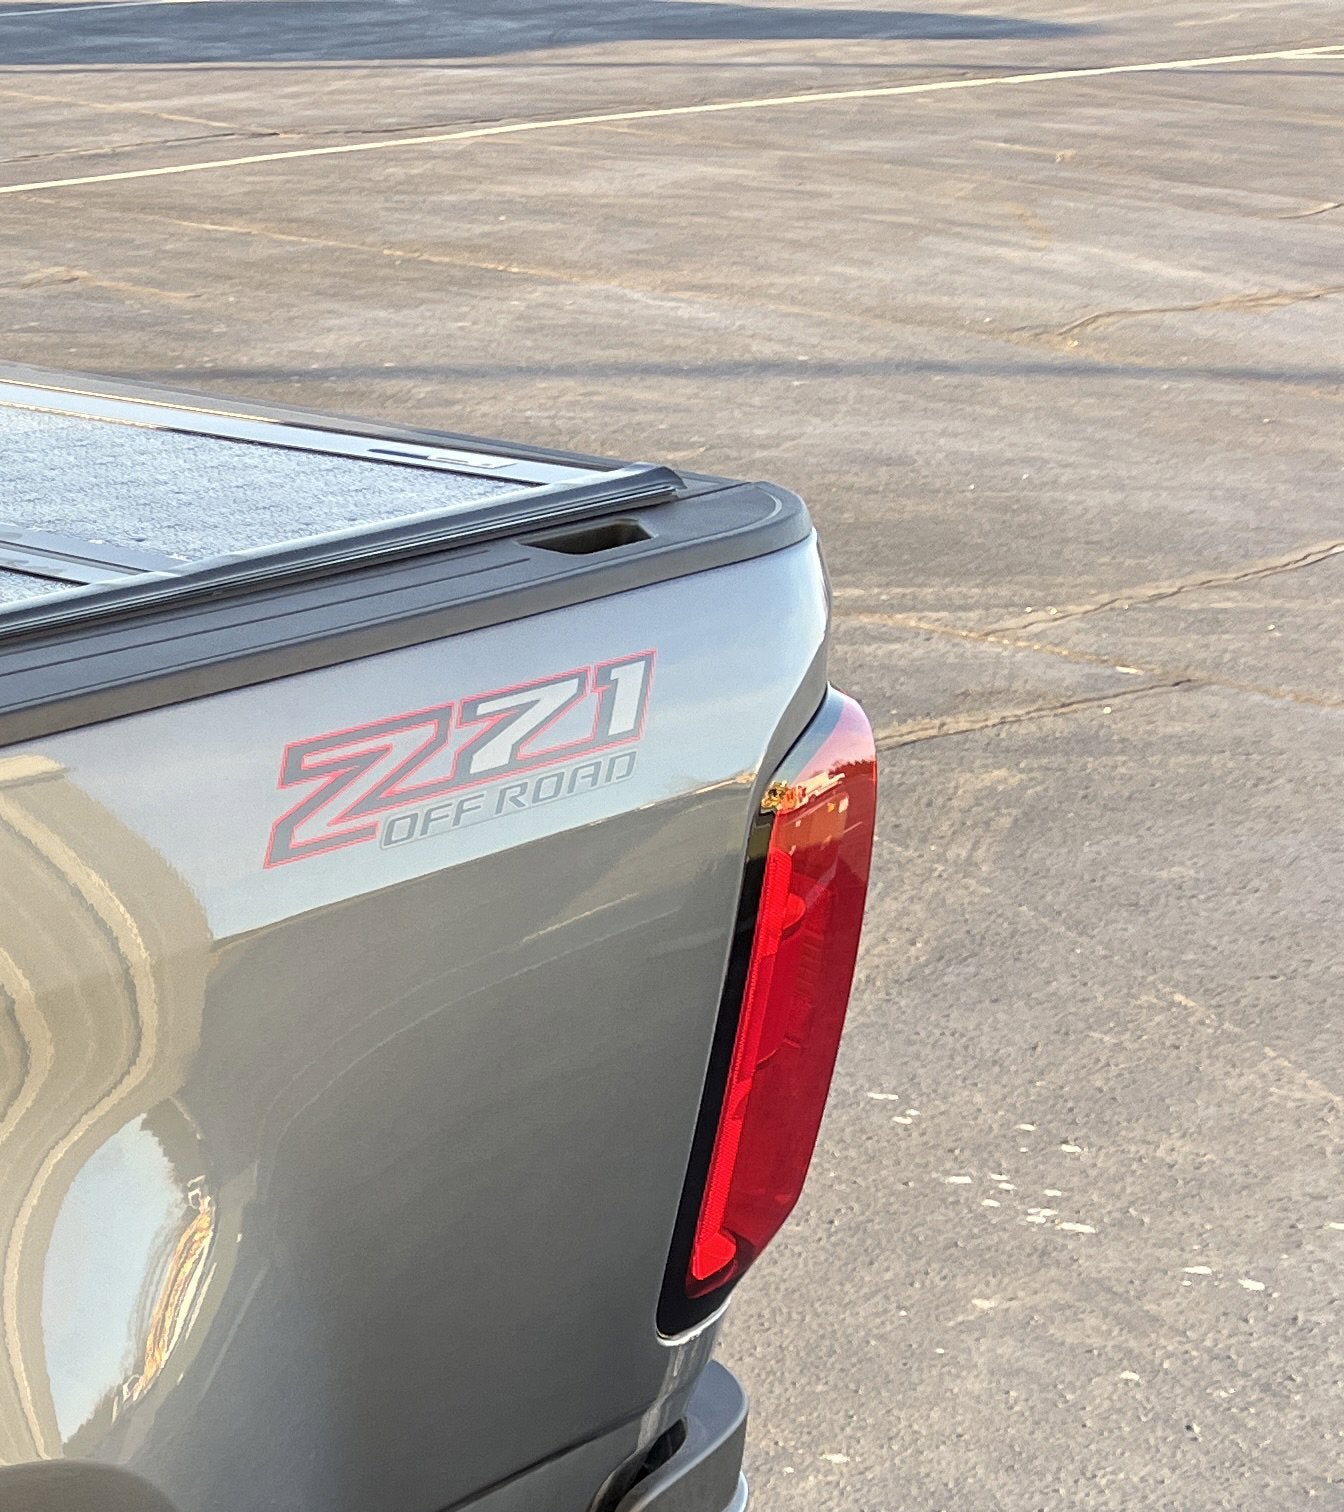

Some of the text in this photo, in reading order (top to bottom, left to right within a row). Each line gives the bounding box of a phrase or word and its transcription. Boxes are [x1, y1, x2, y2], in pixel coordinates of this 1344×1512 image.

[263, 648, 658, 870] Z71
[382, 749, 638, 848] OFF ROAD
